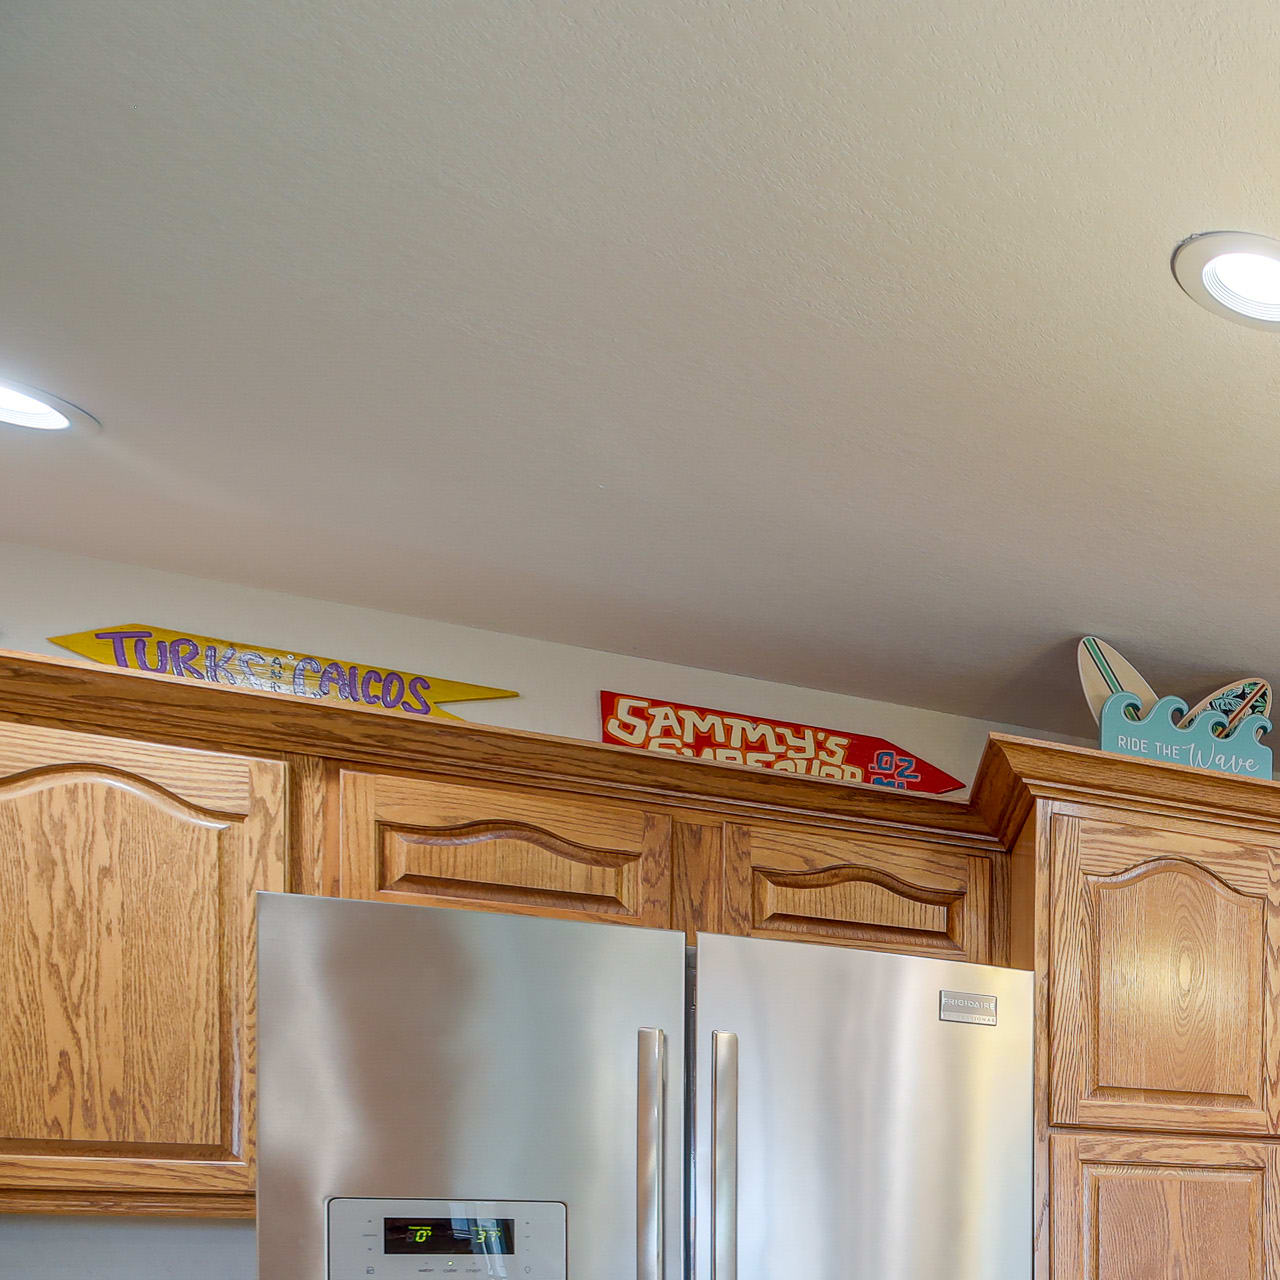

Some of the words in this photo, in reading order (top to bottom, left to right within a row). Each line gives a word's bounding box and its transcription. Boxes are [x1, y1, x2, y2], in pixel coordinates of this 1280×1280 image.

[293, 657, 431, 715] CAICOS
[606, 698, 849, 766] SAMMY'S
[1118, 735, 1149, 753] RIDE
[1155, 742, 1180, 759] THE
[1181, 743, 1260, 773] Wave
[943, 998, 995, 1010] FRIGIDAIRE
